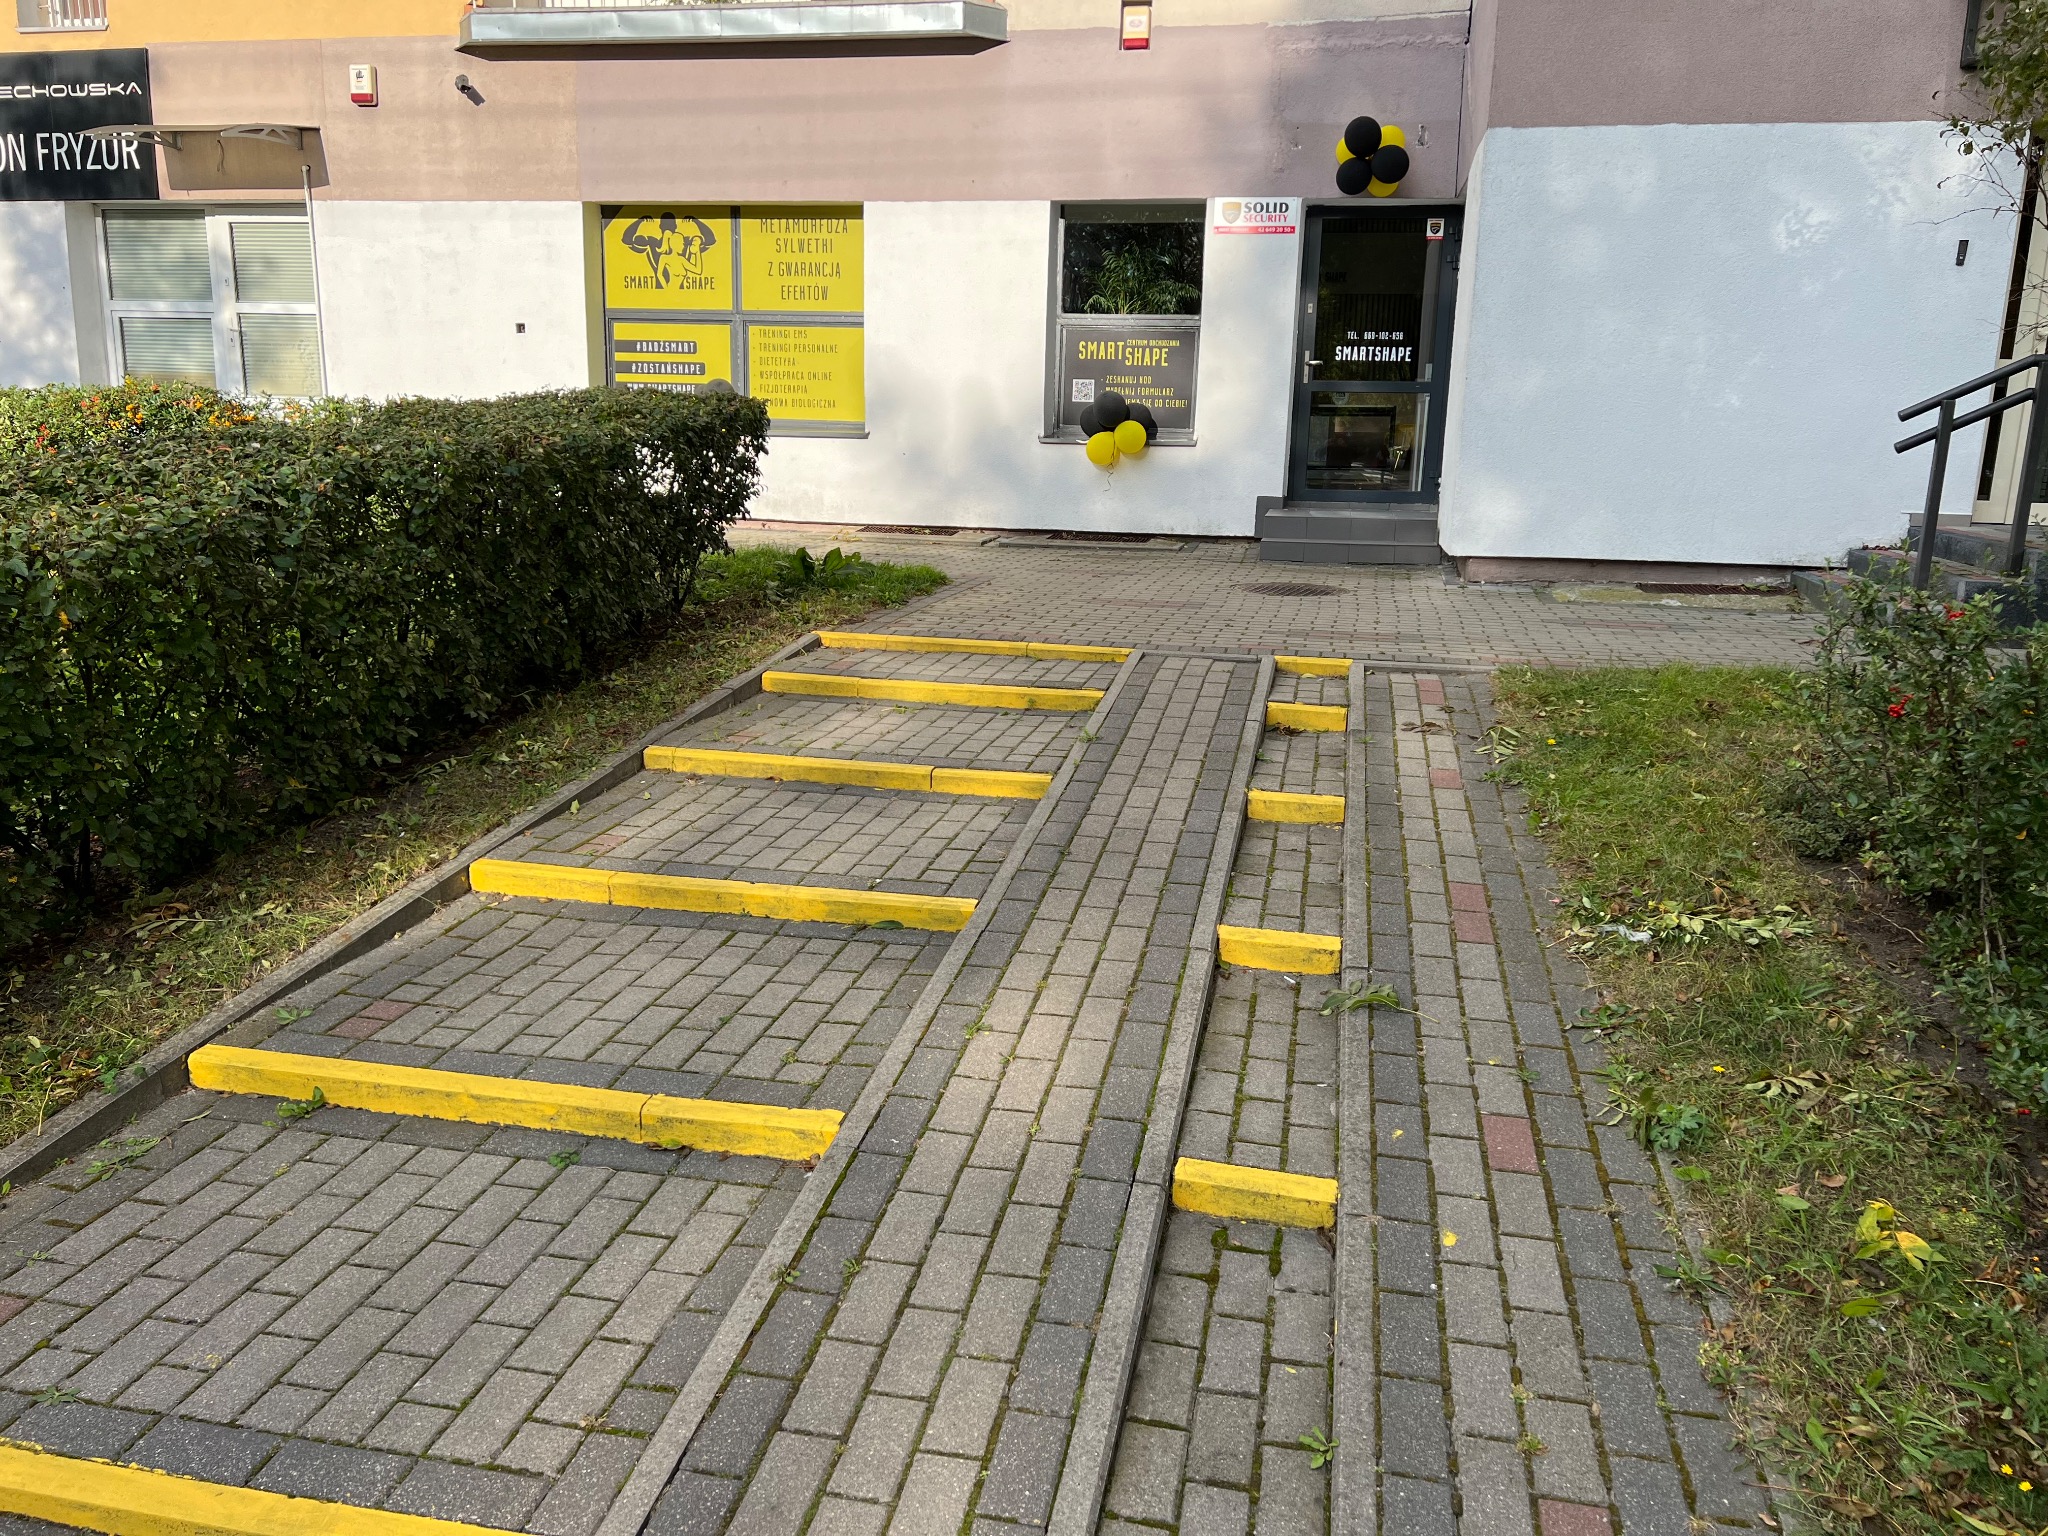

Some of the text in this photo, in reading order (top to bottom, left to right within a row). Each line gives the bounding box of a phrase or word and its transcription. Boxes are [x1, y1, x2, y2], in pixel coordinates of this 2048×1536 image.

[36, 131, 141, 171] FRYZUR
[1244, 202, 1290, 213] SOLID
[1244, 213, 1288, 223] SECURITY
[760, 217, 848, 234] METAMORFOZA
[775, 237, 833, 254] SYLWETKI
[767, 261, 841, 280] Z GWARANCJĄ
[624, 275, 655, 289] SMART
[685, 276, 715, 290] SHAPE
[781, 282, 829, 301] EFEKTÓW
[759, 329, 808, 339] TRENINGI EMS
[1347, 331, 1359, 340] TEL.
[759, 343, 838, 353] TRENINGI PERSONALNE
[1079, 341, 1169, 367] SMART SHAPE
[1335, 345, 1413, 362] SMARTSHAPE
[759, 356, 796, 366] DIETETYKA
[760, 369, 832, 381] WSPÓŁPRACA ONLINE
[760, 384, 808, 394] FIZJOTERAPIA
[1137, 387, 1174, 397] FORMULARZ
[791, 399, 836, 409] BIOLOGICZNA
